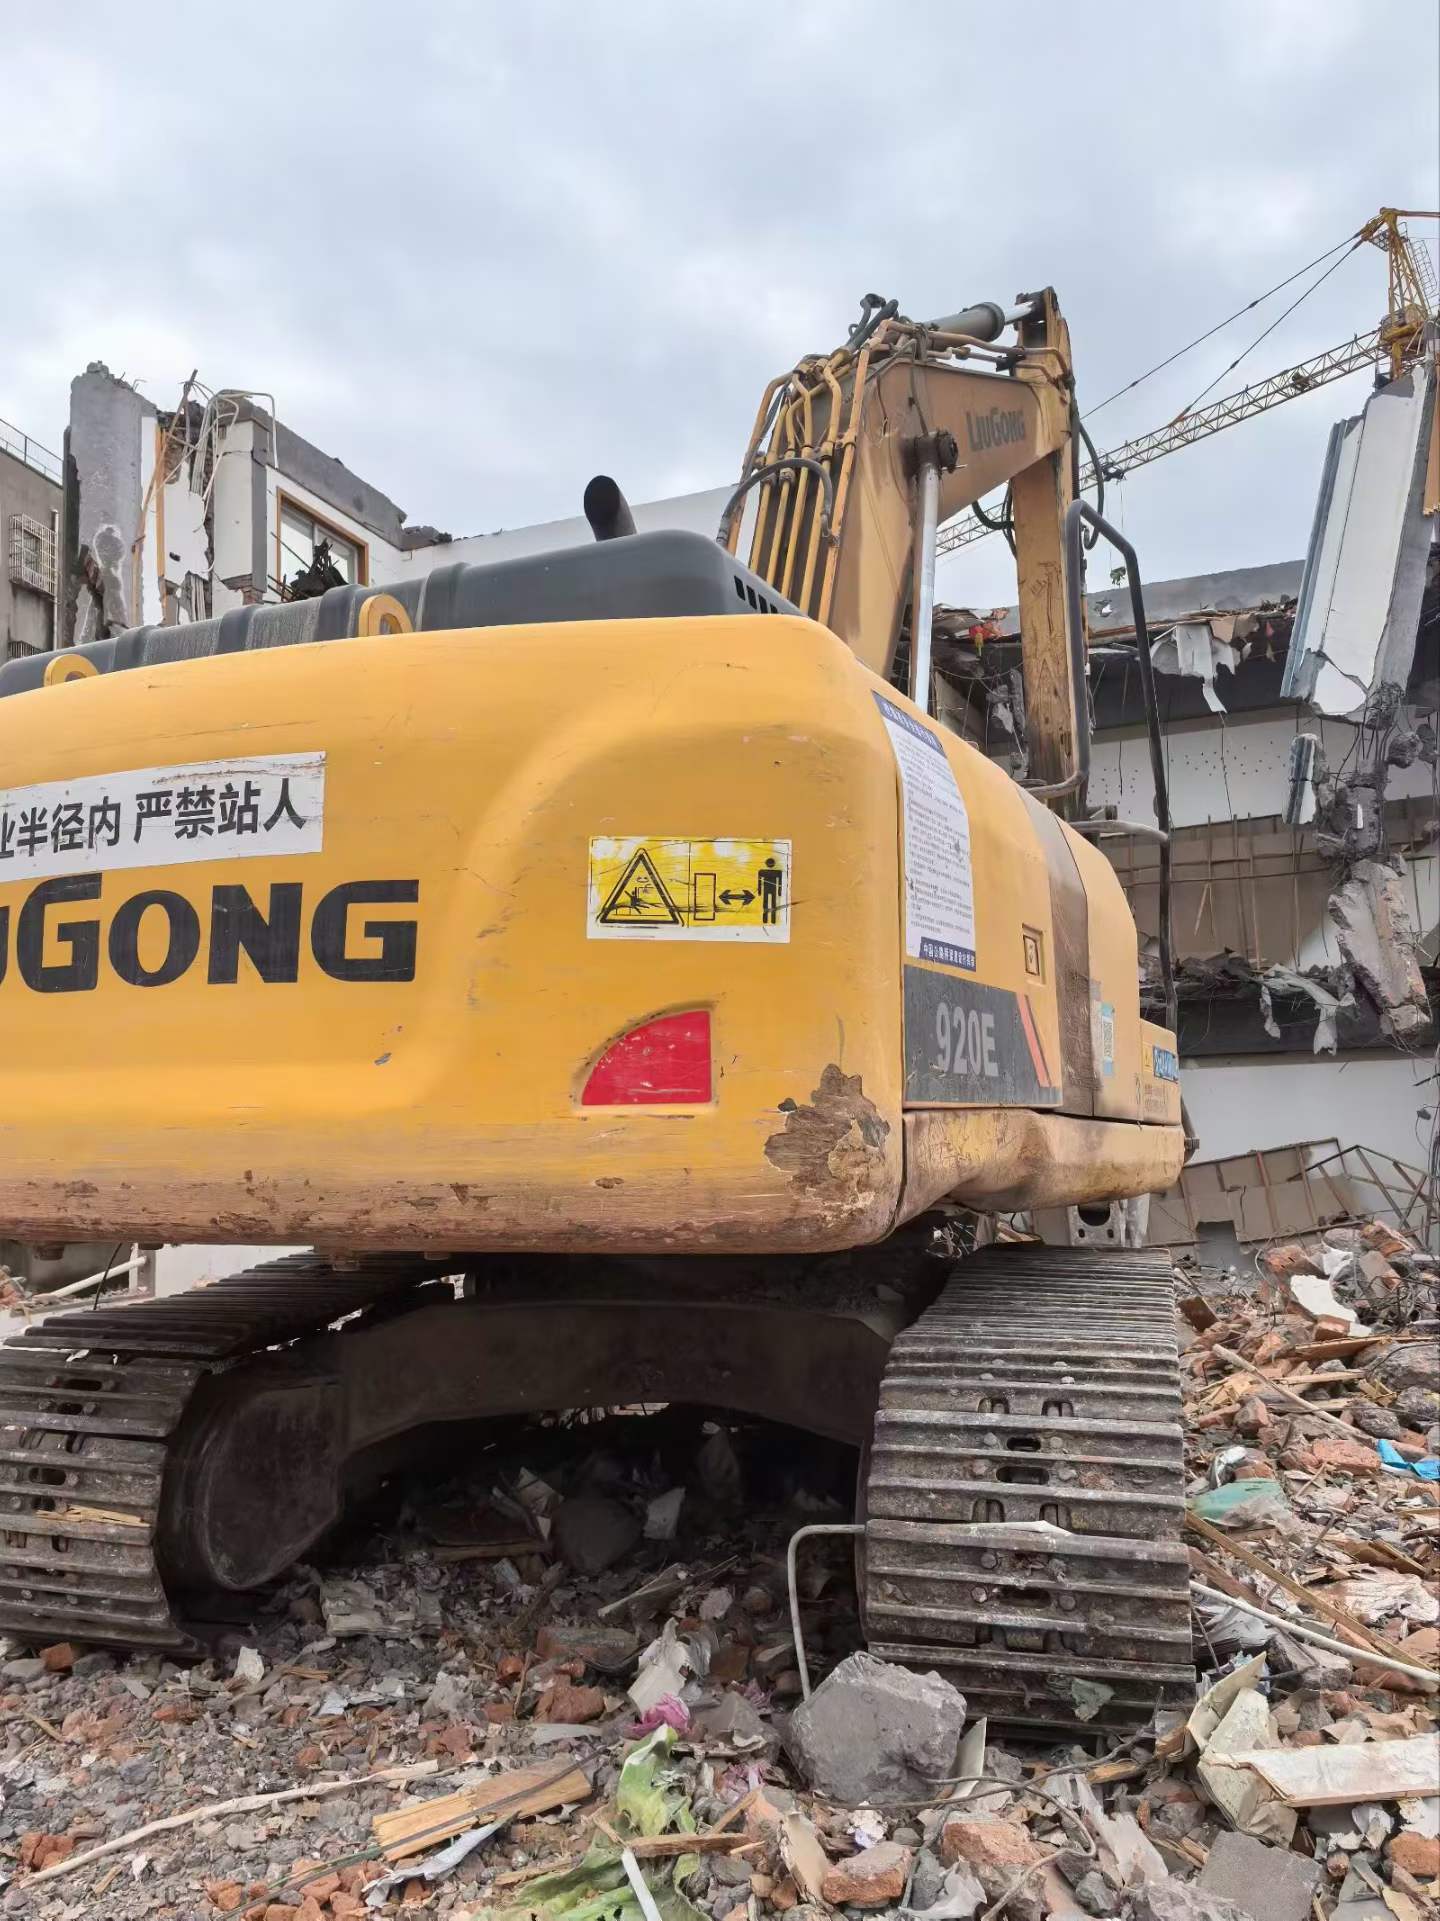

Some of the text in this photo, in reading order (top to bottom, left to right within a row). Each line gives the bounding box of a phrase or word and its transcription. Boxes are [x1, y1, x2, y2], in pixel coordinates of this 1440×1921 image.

[134, 778, 307, 843] 严禁站人
[0, 872, 419, 993] GONG
[936, 1002, 999, 1077] 920E
